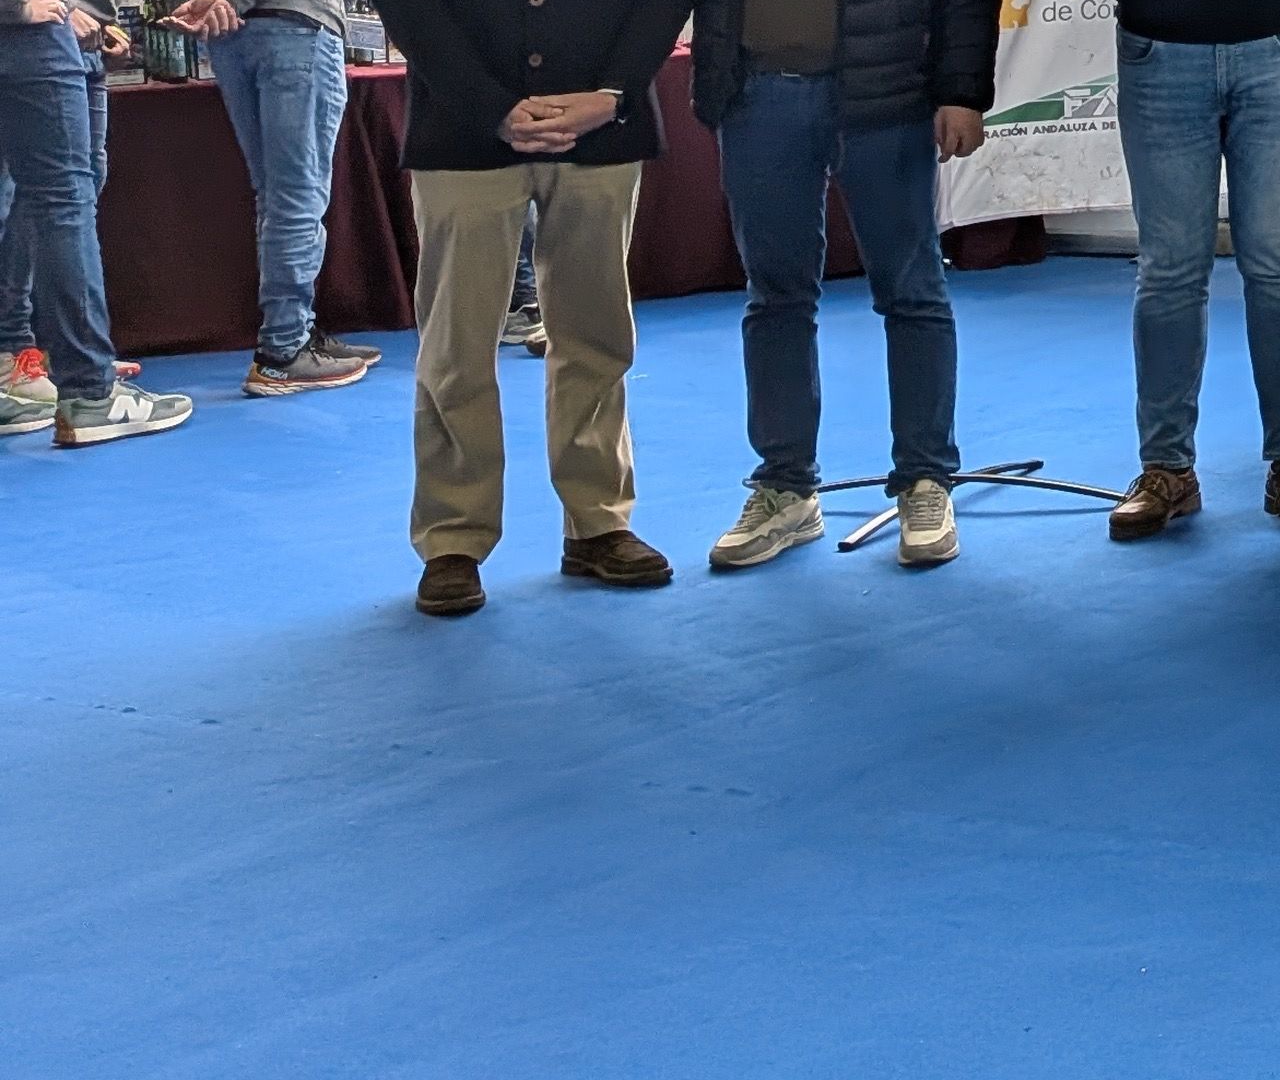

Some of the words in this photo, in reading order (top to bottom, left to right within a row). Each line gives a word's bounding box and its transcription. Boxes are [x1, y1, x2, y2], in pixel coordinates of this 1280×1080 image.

[1041, 1, 1073, 23] de
[984, 123, 1028, 140] RACIÓN
[1032, 121, 1098, 136] ANDALUZA
[1102, 121, 1117, 131] DE
